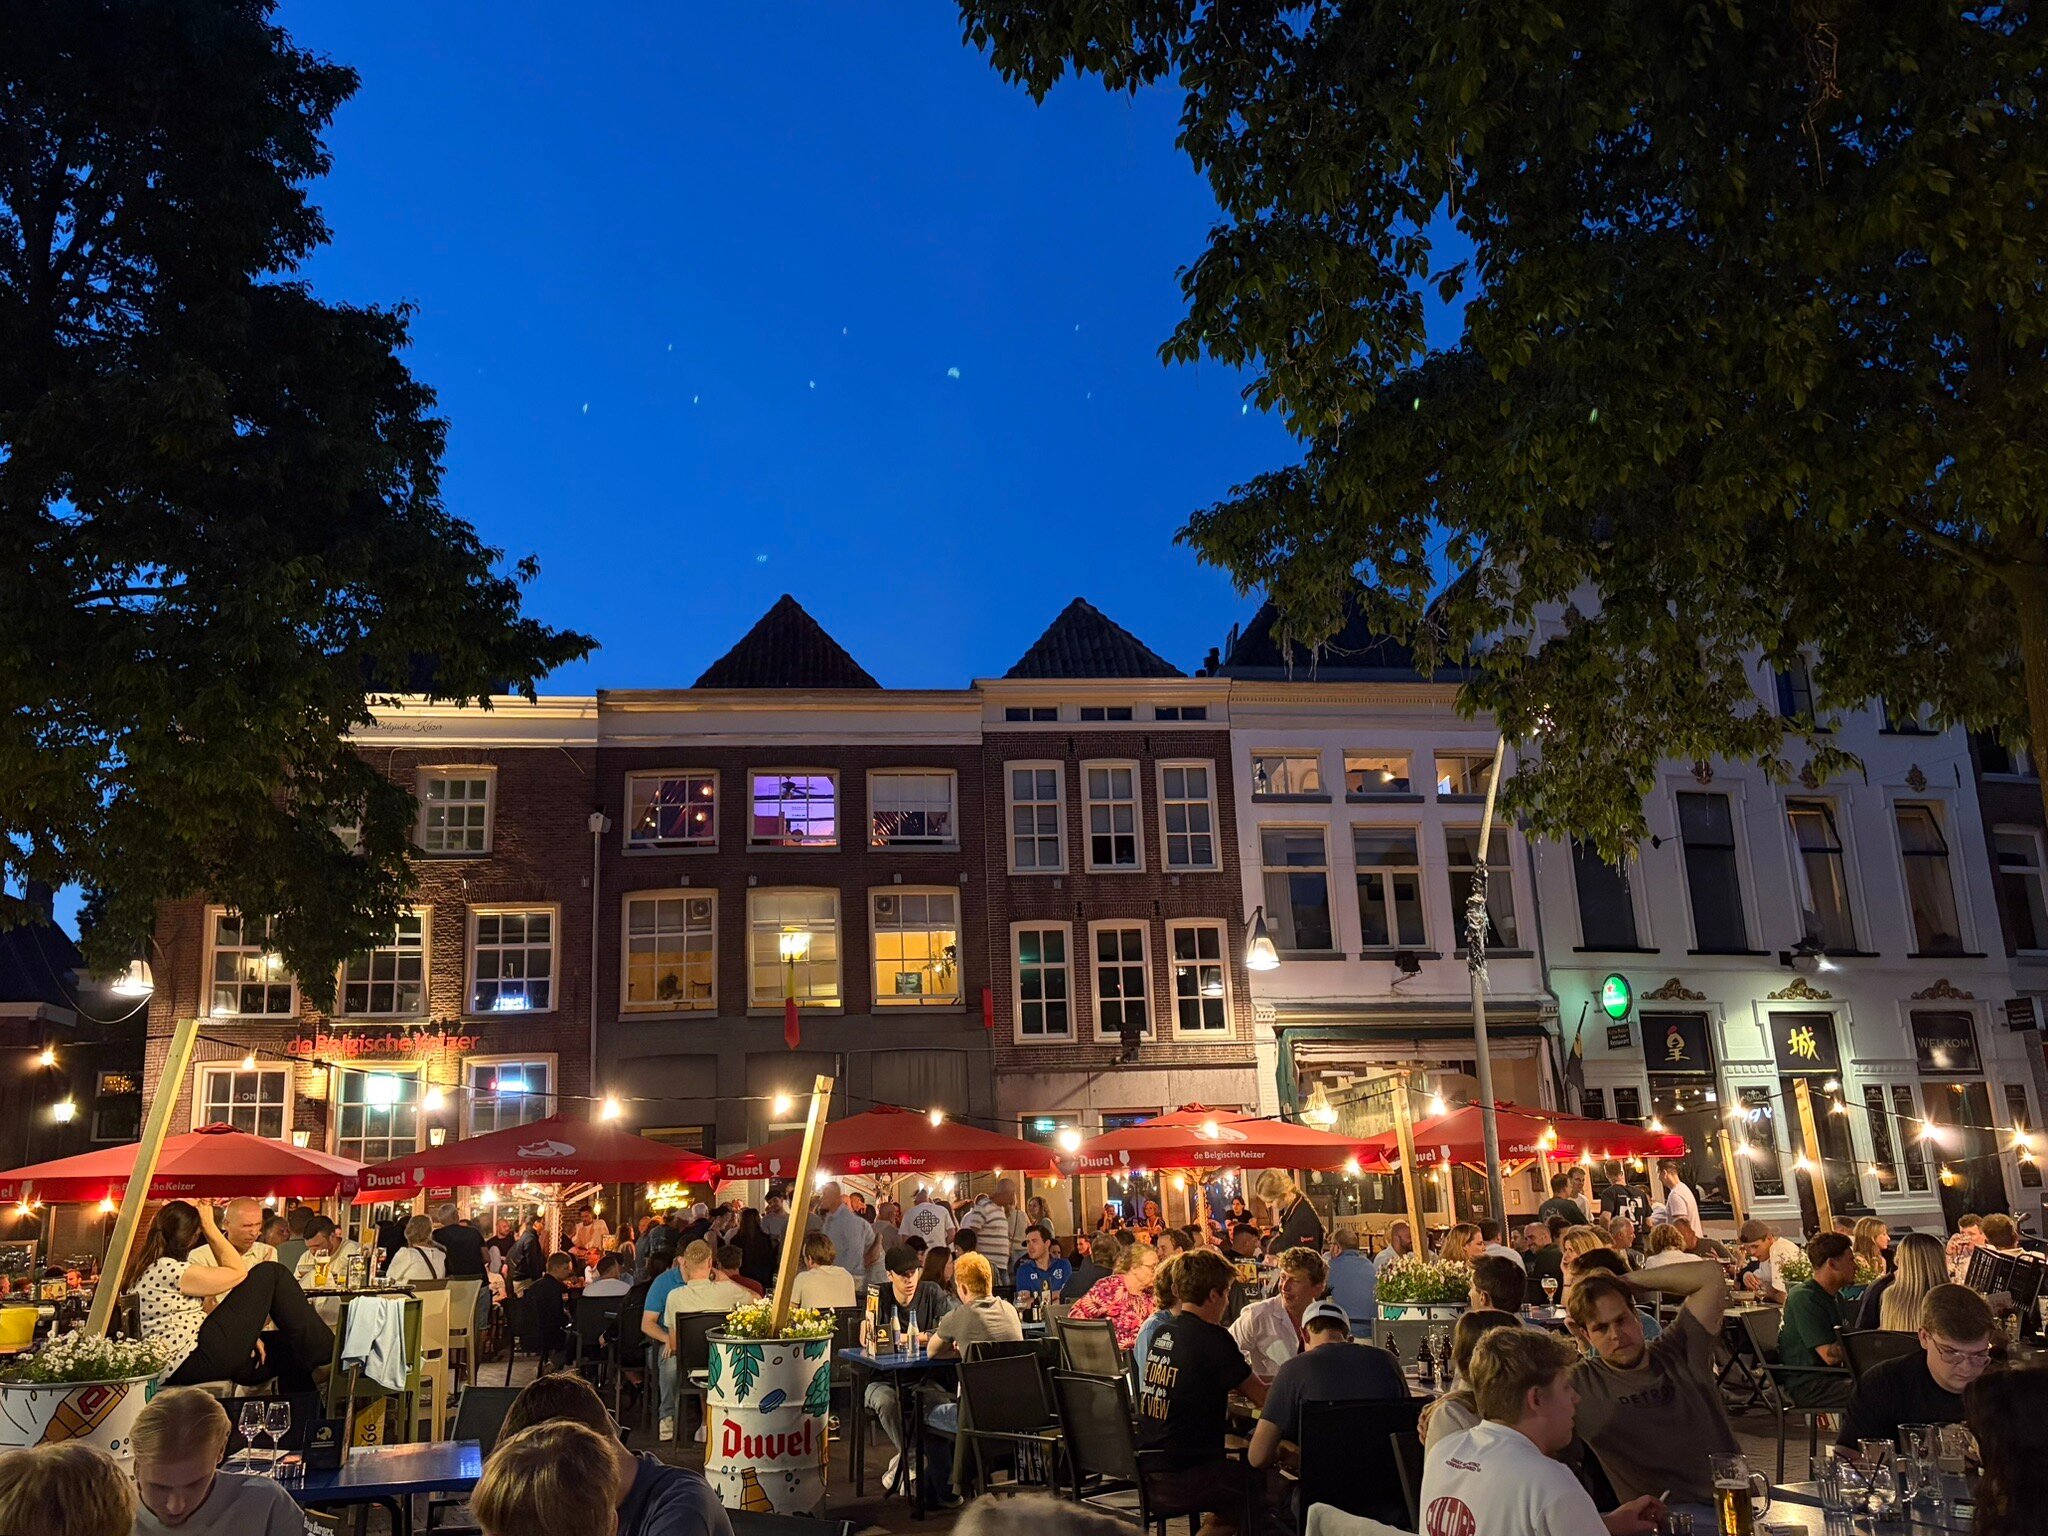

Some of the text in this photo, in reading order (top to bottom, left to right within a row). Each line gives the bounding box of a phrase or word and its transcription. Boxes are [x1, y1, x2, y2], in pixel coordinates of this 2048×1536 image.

[315, 1034, 413, 1059] Belgische
[414, 1032, 480, 1051] Keizer
[1787, 1025, 1821, 1062] 城
[1917, 1036, 1971, 1049] WELKOM
[849, 1156, 927, 1168] de Belgische Keizer
[1079, 1153, 1115, 1168] Duvel
[1193, 1149, 1266, 1161] de Belgische Keizer
[497, 1167, 579, 1178] de Belgische Keizer
[726, 1162, 763, 1177] Duvel
[166, 1182, 196, 1191] Keizer
[366, 1172, 406, 1187] Duvel
[1149, 1362, 1179, 1388] DRAFT
[1147, 1395, 1171, 1420] VIEW
[722, 1418, 812, 1461] Duvel
